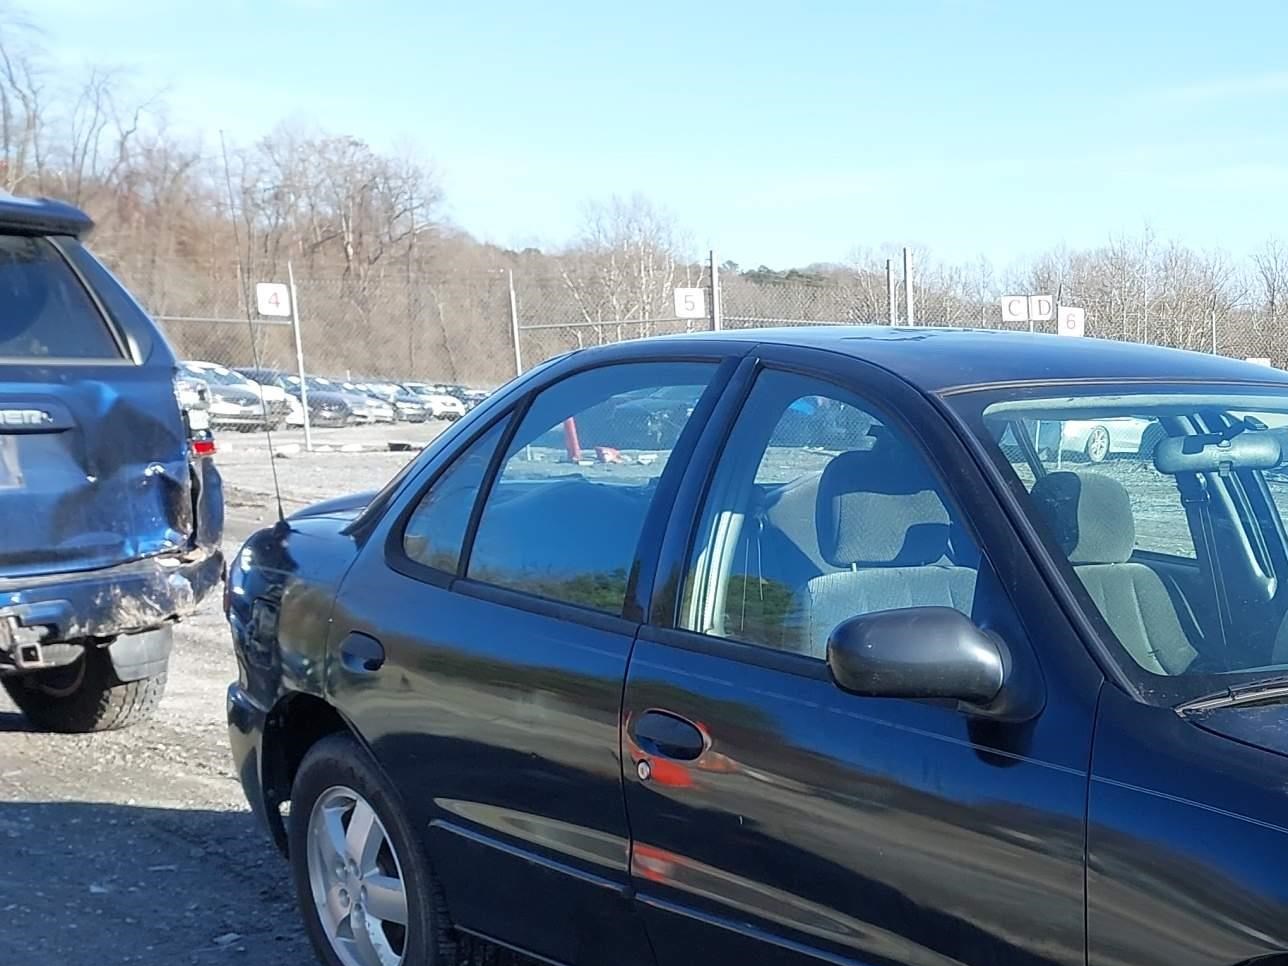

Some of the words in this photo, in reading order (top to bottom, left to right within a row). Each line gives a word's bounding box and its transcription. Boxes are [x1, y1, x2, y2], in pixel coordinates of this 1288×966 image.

[267, 292, 280, 309] 4
[684, 294, 696, 312] 5
[1008, 299, 1021, 316] C
[1038, 299, 1051, 316] D
[1066, 313, 1076, 329] 6
